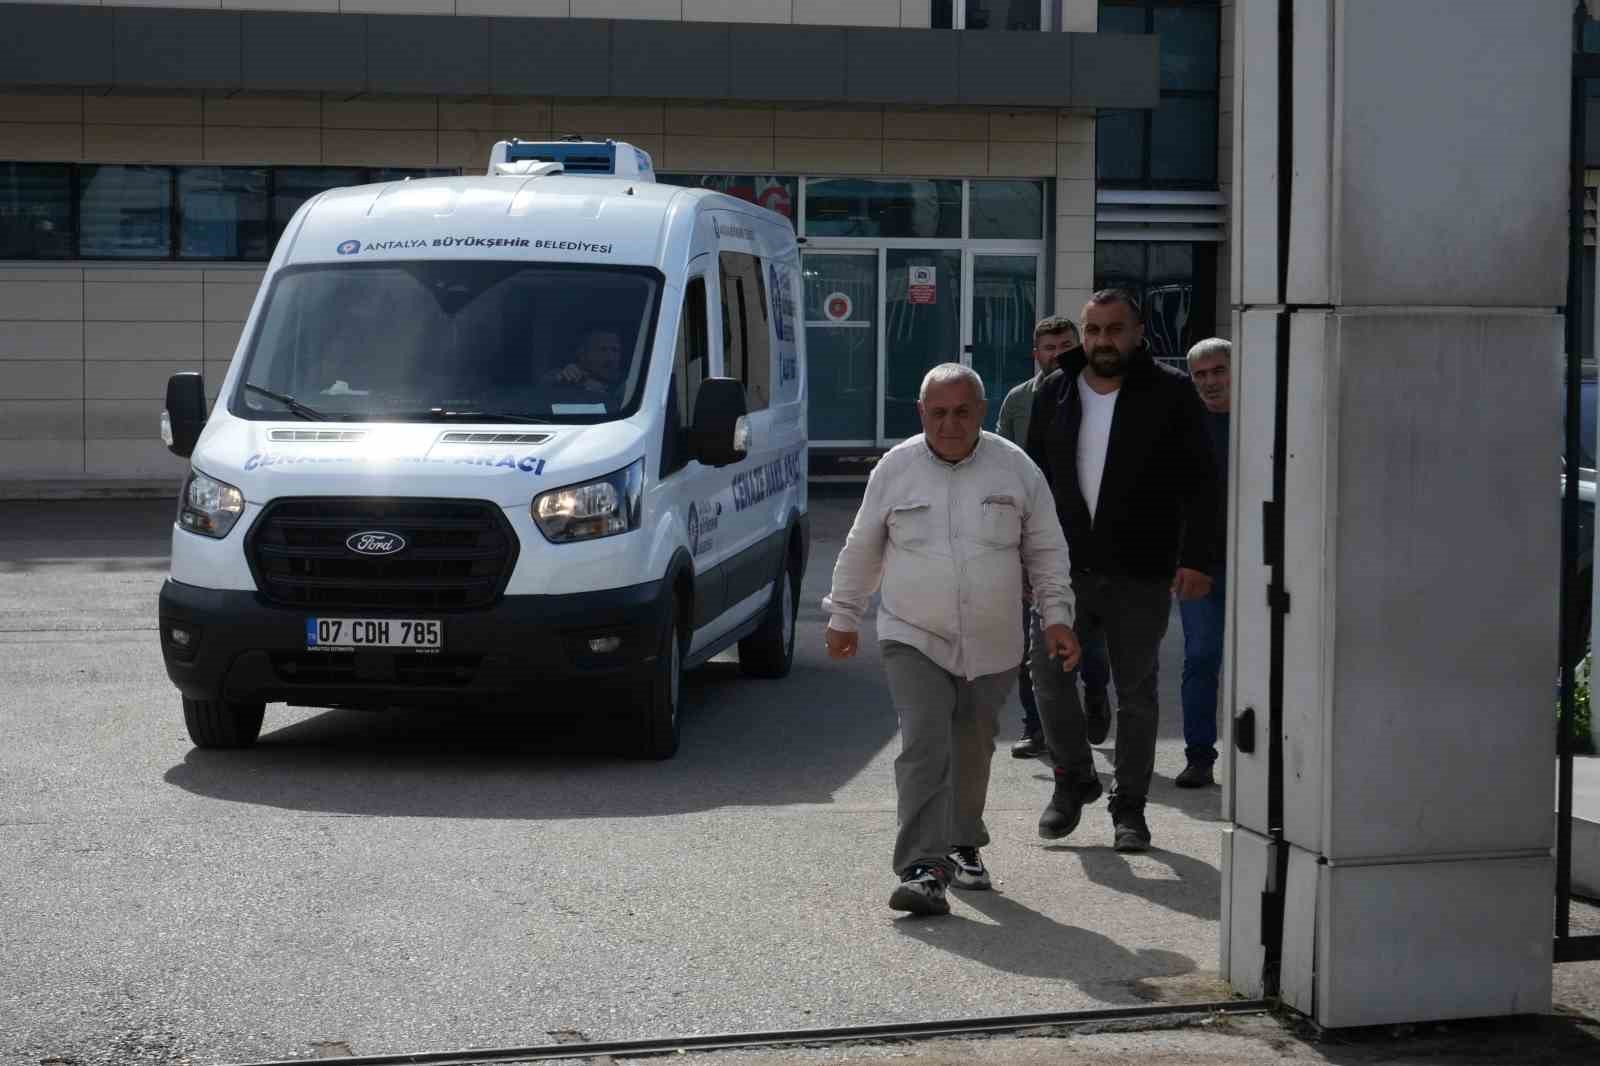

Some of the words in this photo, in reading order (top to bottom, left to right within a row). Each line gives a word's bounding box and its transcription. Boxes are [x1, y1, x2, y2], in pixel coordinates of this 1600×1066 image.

[363, 239, 427, 252] ANTALYA
[432, 236, 530, 249] BÜYÜKŞEHİR
[535, 239, 613, 255] BELEDİYESİ
[357, 534, 394, 551] Ford
[319, 620, 343, 642] 07
[352, 621, 390, 644] CDH
[400, 622, 438, 645] 785
